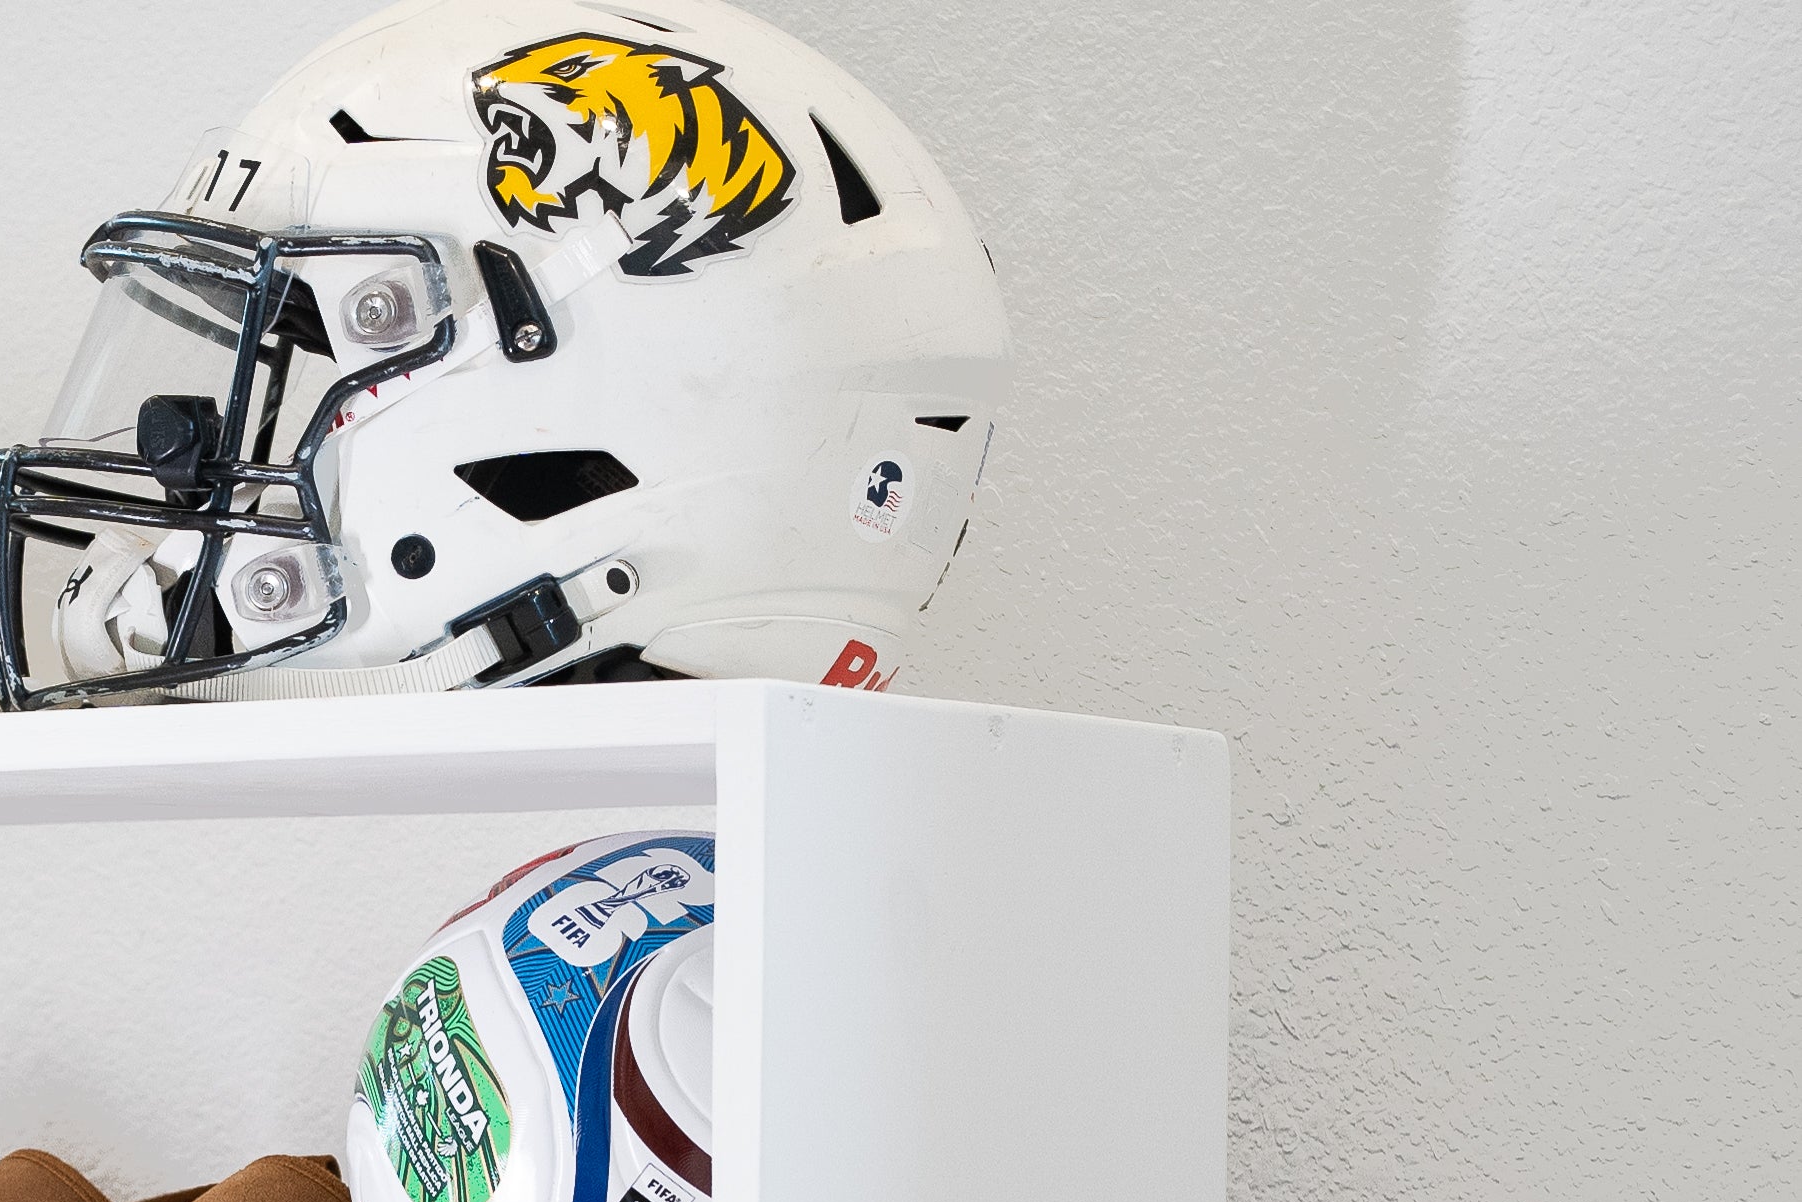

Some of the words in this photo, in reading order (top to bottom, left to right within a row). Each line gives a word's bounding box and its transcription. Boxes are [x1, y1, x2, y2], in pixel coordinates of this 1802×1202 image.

[203, 149, 262, 212] 17
[853, 514, 871, 528] MADE
[879, 526, 892, 536] USA
[856, 501, 897, 530] HELMET
[551, 914, 592, 949] FIFA
[417, 978, 489, 1145] TRIONDA
[413, 1122, 424, 1143] DEL
[422, 1140, 448, 1183] PARTIDO
[446, 1106, 475, 1154] LEAGUE
[405, 1125, 419, 1151] BALL
[417, 1149, 442, 1191] REPLICA
[414, 1161, 437, 1197] MATCH
